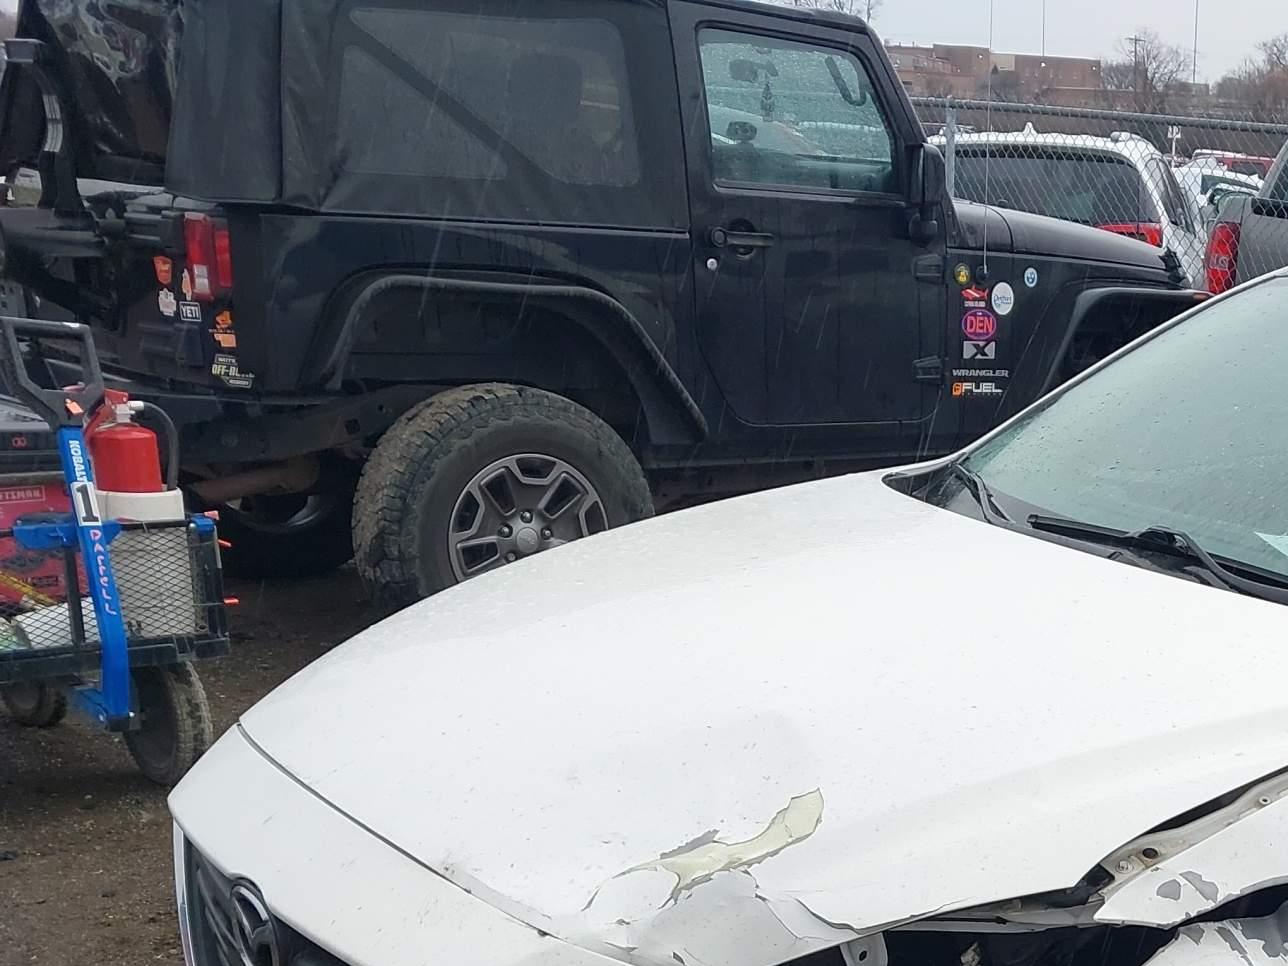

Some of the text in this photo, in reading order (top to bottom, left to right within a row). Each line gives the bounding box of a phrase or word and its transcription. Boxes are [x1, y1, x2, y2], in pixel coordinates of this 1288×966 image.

[181, 305, 199, 318] YETI
[966, 315, 993, 333] DEN
[952, 368, 1009, 378] WRANGLER
[68, 439, 88, 483] KOBALT
[76, 483, 100, 523] 1
